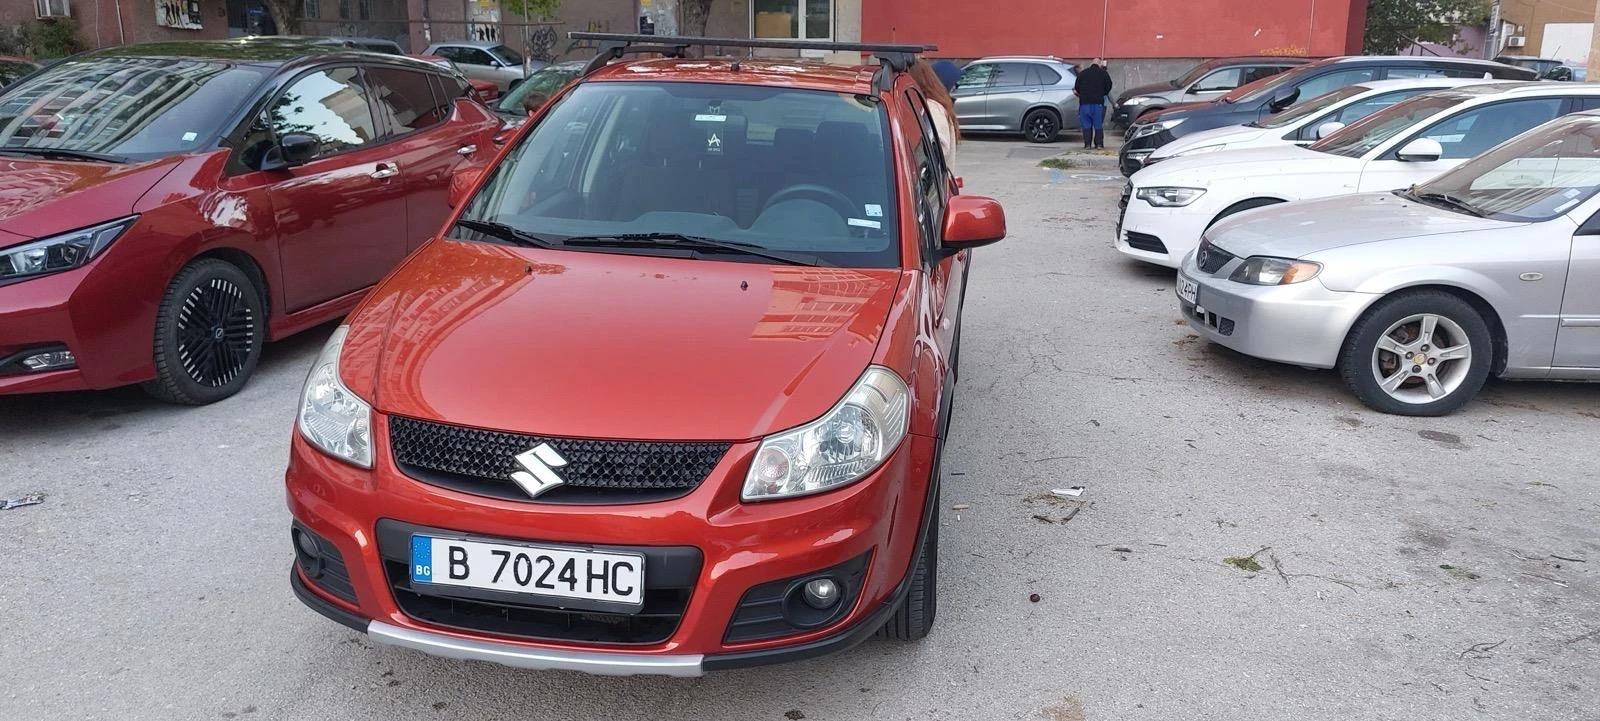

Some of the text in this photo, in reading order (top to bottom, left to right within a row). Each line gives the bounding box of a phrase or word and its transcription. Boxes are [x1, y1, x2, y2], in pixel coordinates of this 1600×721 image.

[1178, 278, 1197, 302] 24PH
[415, 564, 431, 577] BG
[448, 545, 470, 581] B
